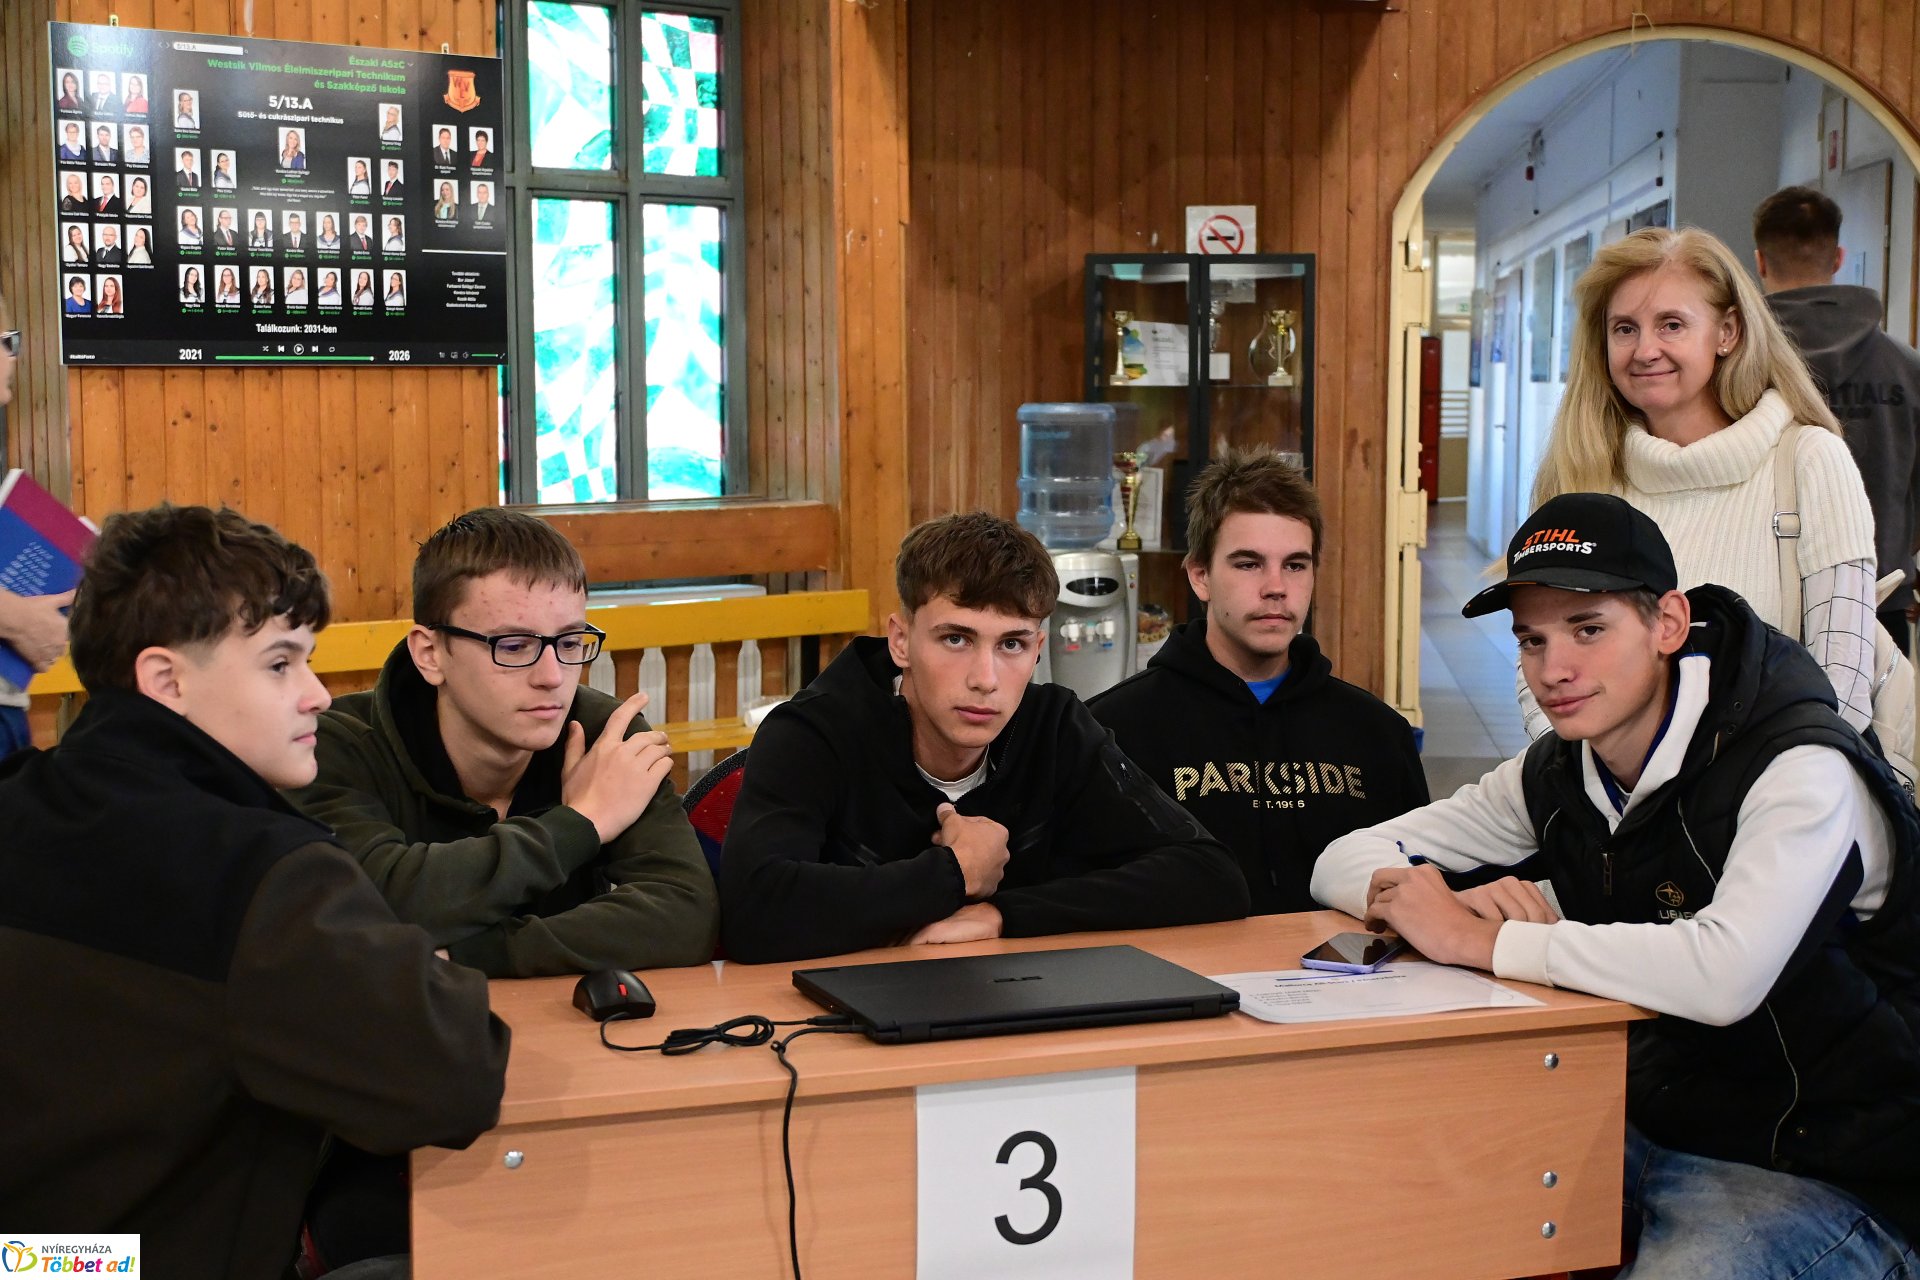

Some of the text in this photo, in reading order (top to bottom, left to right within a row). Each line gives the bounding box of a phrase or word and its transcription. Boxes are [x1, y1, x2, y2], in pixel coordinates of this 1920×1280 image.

[92, 43, 134, 57] Spotify
[349, 56, 405, 69] Északi ASzC
[207, 59, 405, 81] Westsik Vilmos Élelmiszeripari Technikum
[314, 80, 406, 94] és Szakképző Iskola
[268, 95, 313, 110] 5/13.A
[268, 113, 310, 123] cukrászipari
[311, 116, 344, 124] technikus
[256, 324, 338, 334] Találkozunk: 2031-ben
[179, 349, 202, 360] 2021
[389, 350, 411, 361] 2026
[1522, 529, 1580, 551] STIHL
[1173, 761, 1367, 802] PARKSIDE
[1252, 799, 1274, 809] ET.
[994, 1130, 1062, 1245] 3
